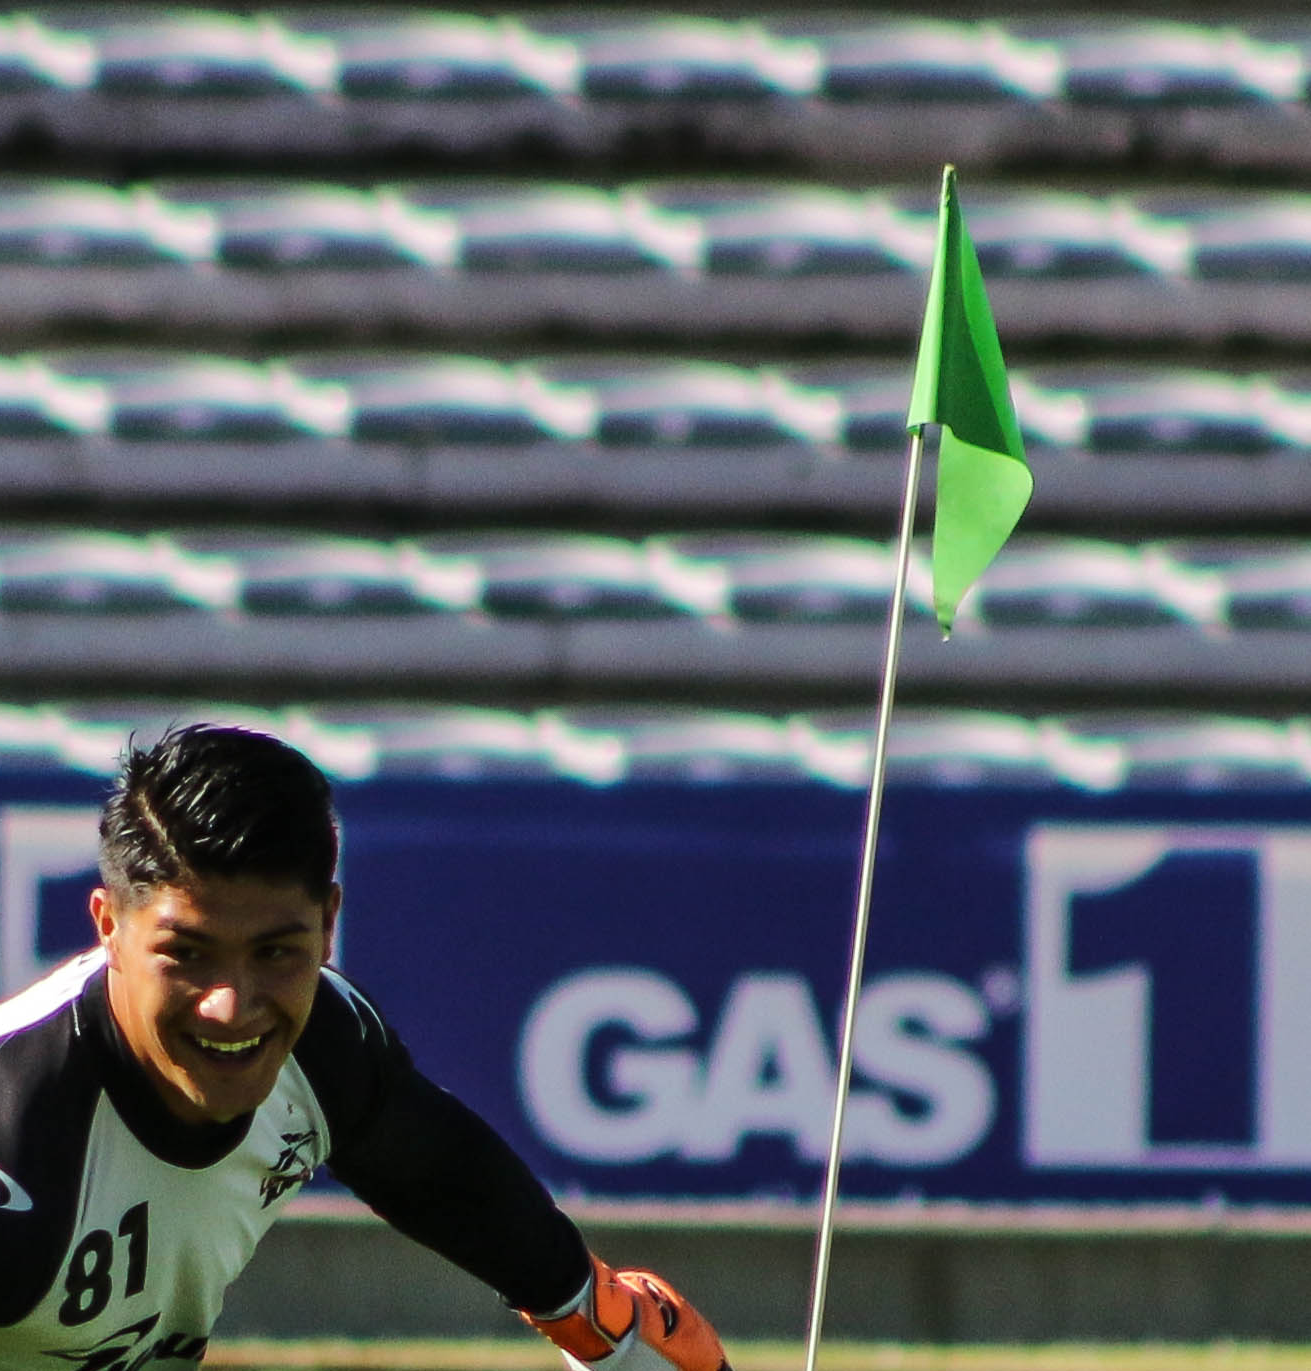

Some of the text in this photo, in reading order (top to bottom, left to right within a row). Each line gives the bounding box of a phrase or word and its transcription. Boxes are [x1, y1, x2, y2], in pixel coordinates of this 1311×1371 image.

[518, 847, 1260, 1166] GAS 1
[58, 1200, 149, 1326] 81
